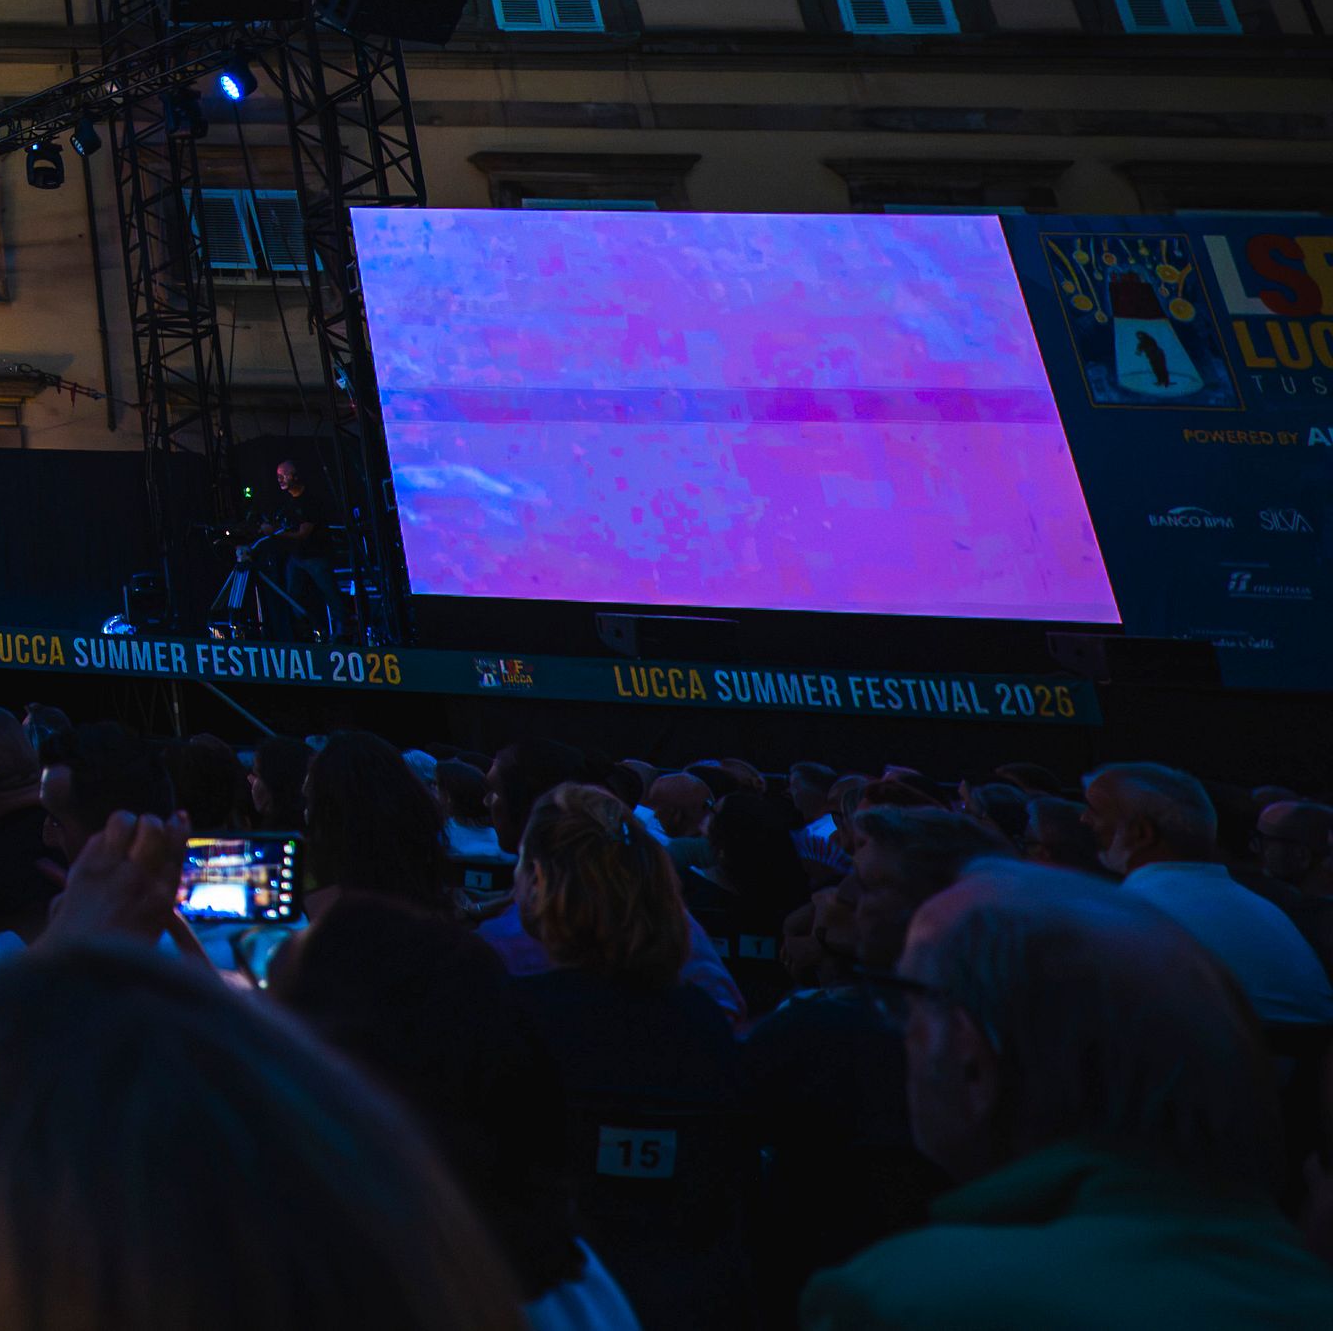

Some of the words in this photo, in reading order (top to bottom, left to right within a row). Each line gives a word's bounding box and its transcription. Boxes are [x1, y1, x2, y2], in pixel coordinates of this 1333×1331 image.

[1183, 428, 1274, 446] POWERED
[1277, 431, 1299, 446] BY
[73, 637, 188, 674] SUMMER
[195, 643, 323, 680] FESTIVAL
[329, 650, 401, 685] 2026
[613, 665, 708, 701] LUCCA
[713, 669, 841, 708] SUMMER
[848, 676, 989, 715] FESTIVAL
[995, 683, 1074, 719] 2026
[618, 1140, 660, 1168] 15
